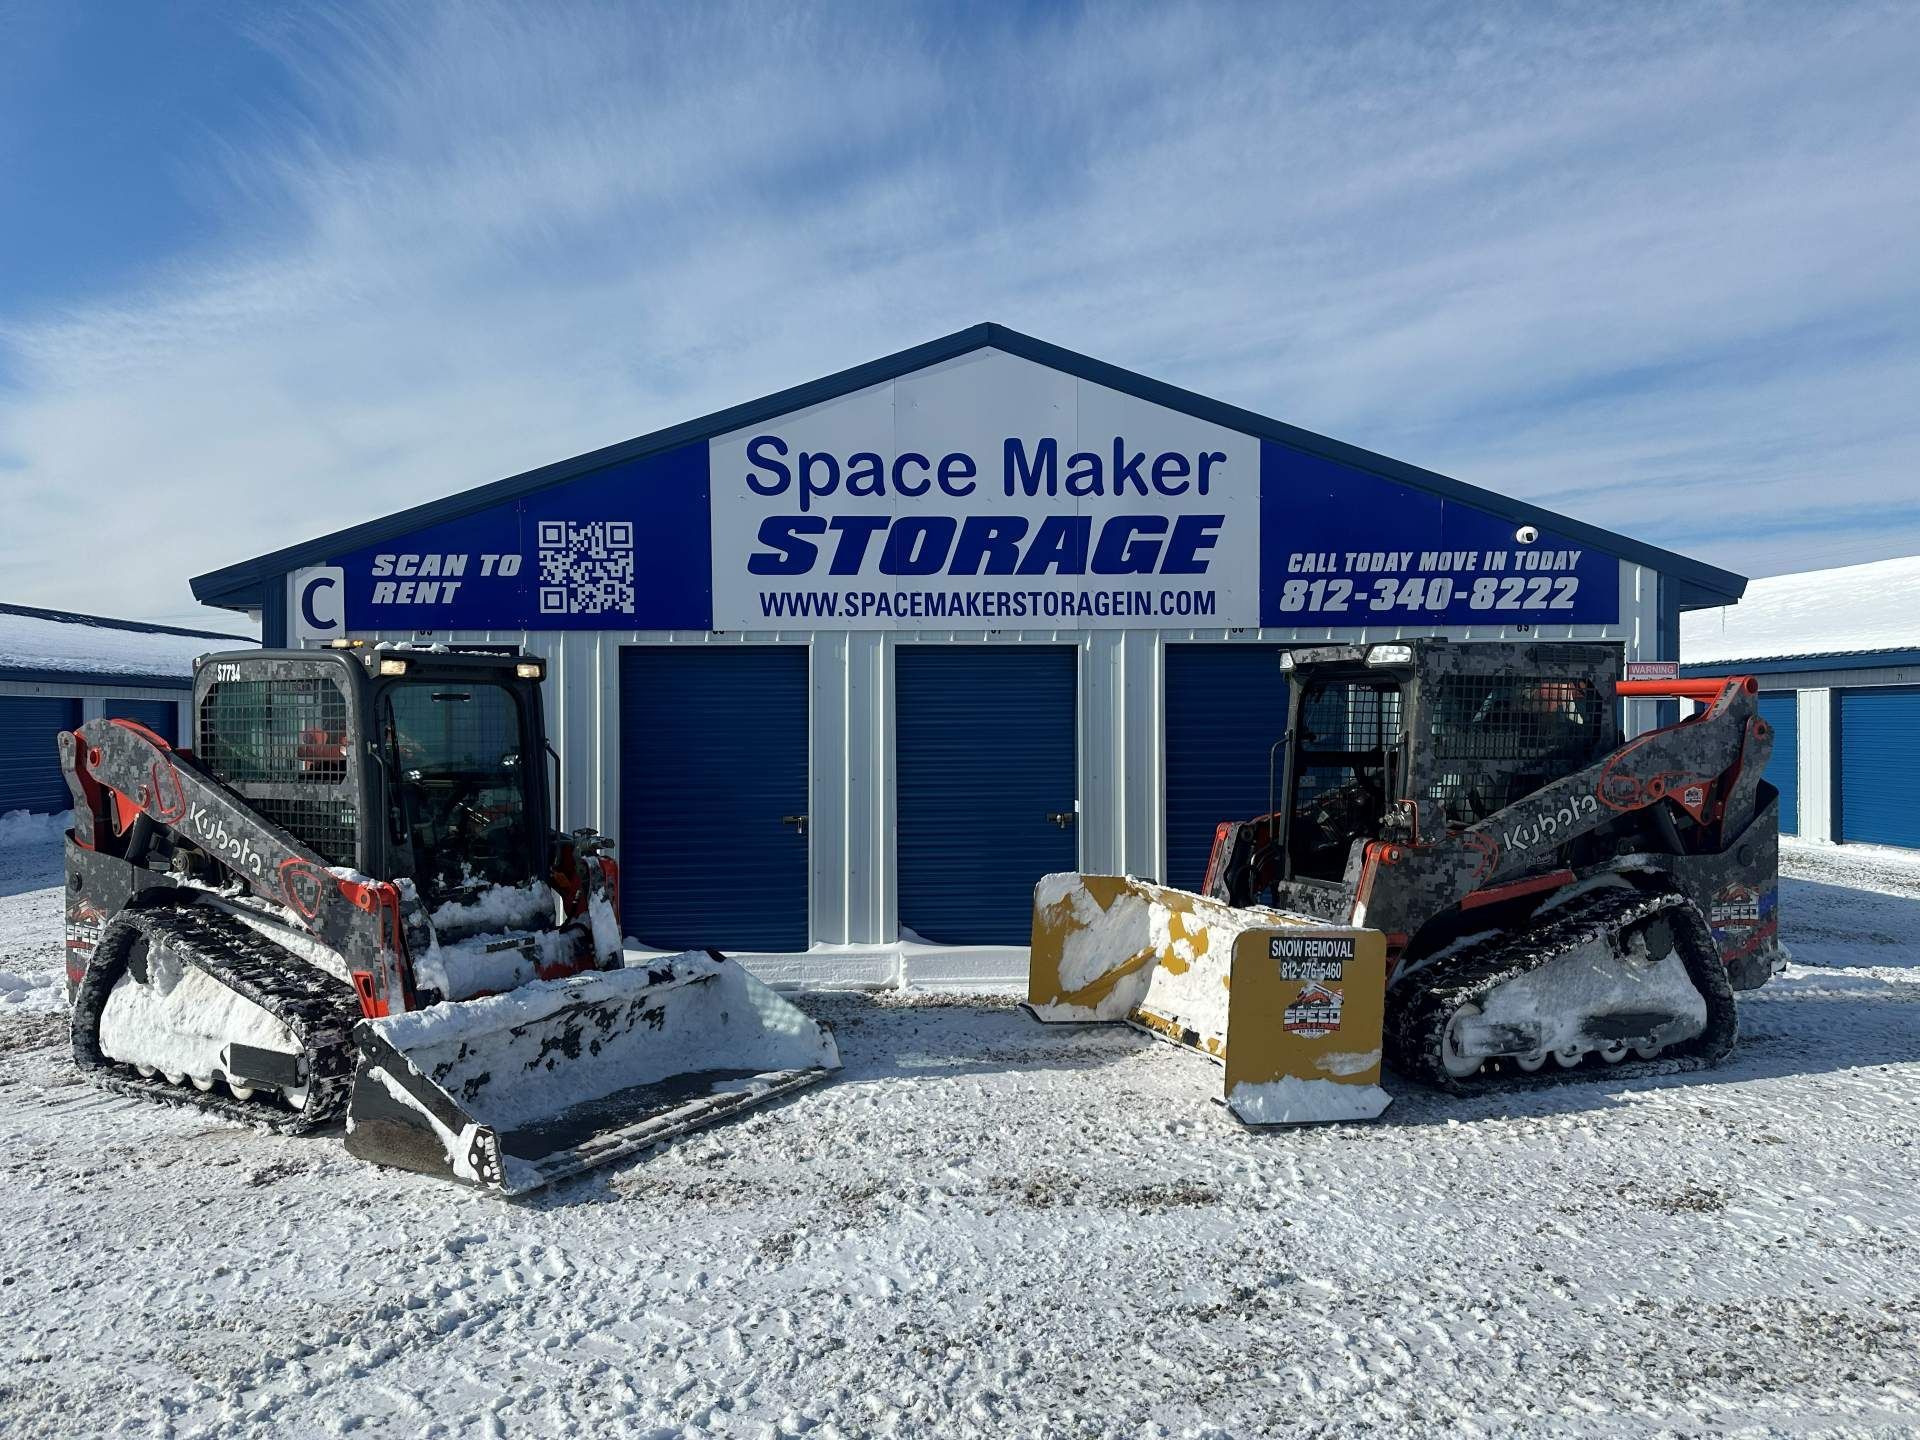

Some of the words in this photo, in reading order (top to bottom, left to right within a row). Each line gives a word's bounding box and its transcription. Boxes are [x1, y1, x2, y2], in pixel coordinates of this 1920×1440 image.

[746, 435, 976, 513] Space
[1004, 437, 1227, 497] Maker
[747, 515, 1225, 576] STORAGE
[371, 554, 468, 577] SCAN
[481, 554, 523, 577] TO
[1287, 553, 1337, 573] CALL
[1345, 552, 1414, 573] TODAY
[1419, 552, 1479, 572] MOVE
[1483, 551, 1508, 571] IN
[1515, 550, 1582, 571] TODAY
[302, 577, 338, 630] C
[371, 581, 462, 604] RENT
[760, 590, 1216, 618] WWW.SPACEMAKERSTORAGEIN.COM
[1279, 577, 1579, 612] 812-340-8222
[1631, 665, 1674, 674] WARNING
[1503, 794, 1598, 851] Kubota
[190, 801, 262, 876] Kubota
[1711, 905, 1760, 922] SPEED
[1271, 940, 1303, 957] SNOW
[1304, 940, 1354, 958] REMOVAL
[1281, 961, 1342, 979] 812-276-5460
[1283, 1008, 1341, 1025] SPEED
